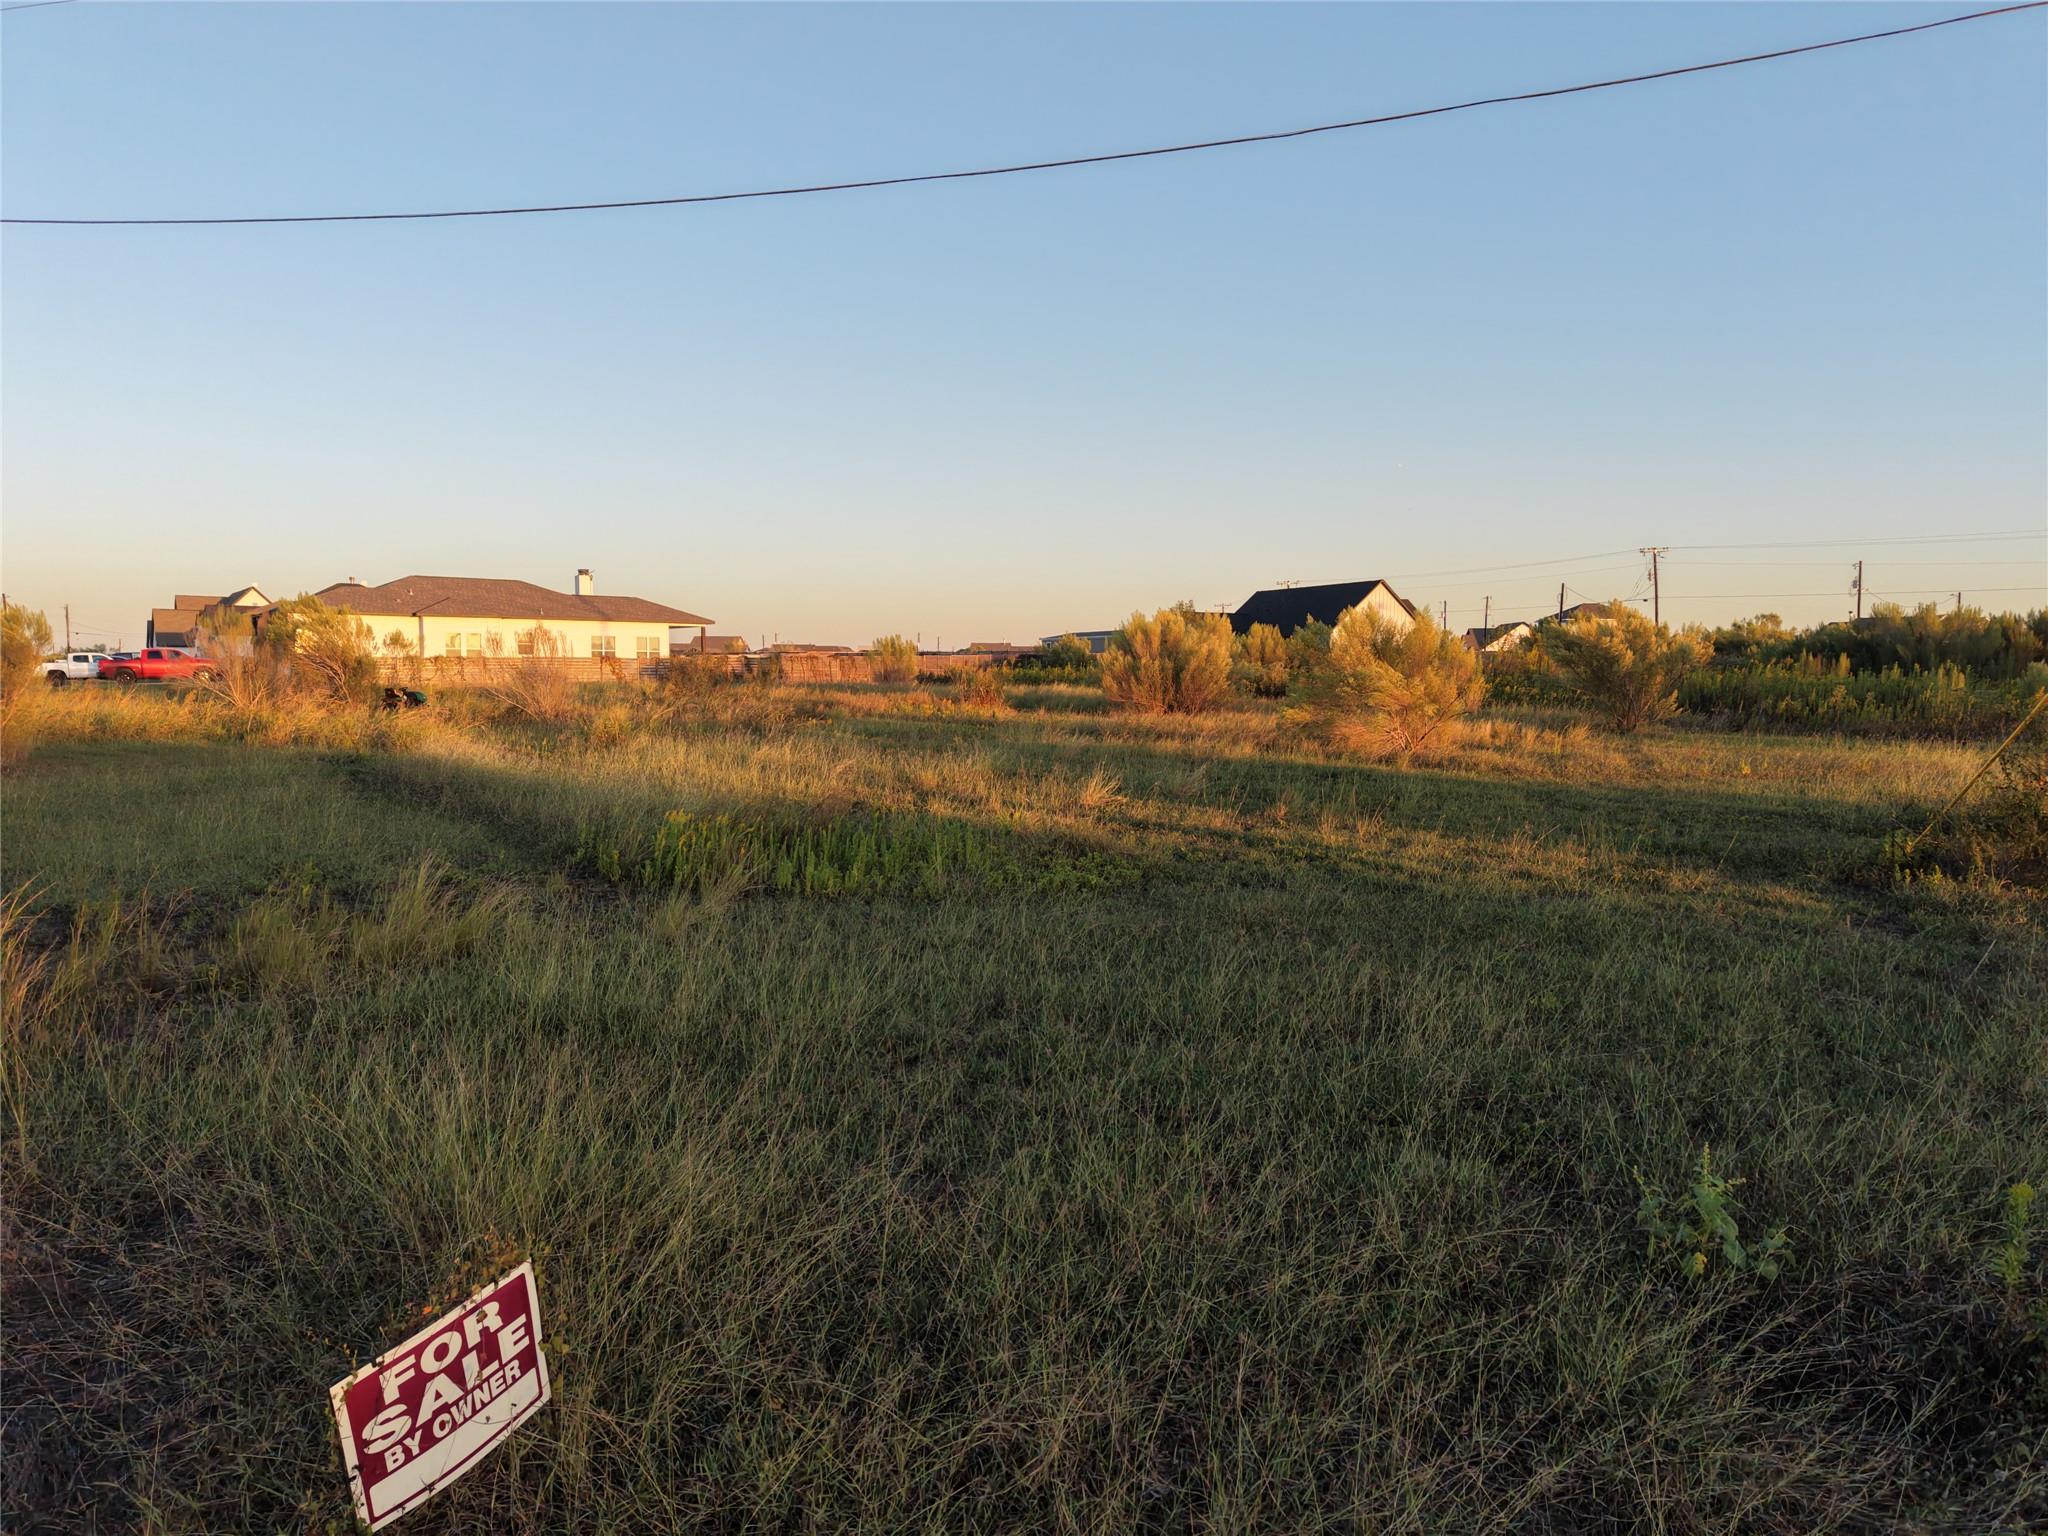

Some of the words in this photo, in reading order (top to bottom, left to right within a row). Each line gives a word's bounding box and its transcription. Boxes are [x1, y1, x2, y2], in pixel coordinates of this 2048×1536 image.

[361, 1313, 530, 1455] SALE
[379, 1301, 503, 1405] FOR
[383, 1429, 423, 1473] BY
[432, 1359, 522, 1439] OWNER
